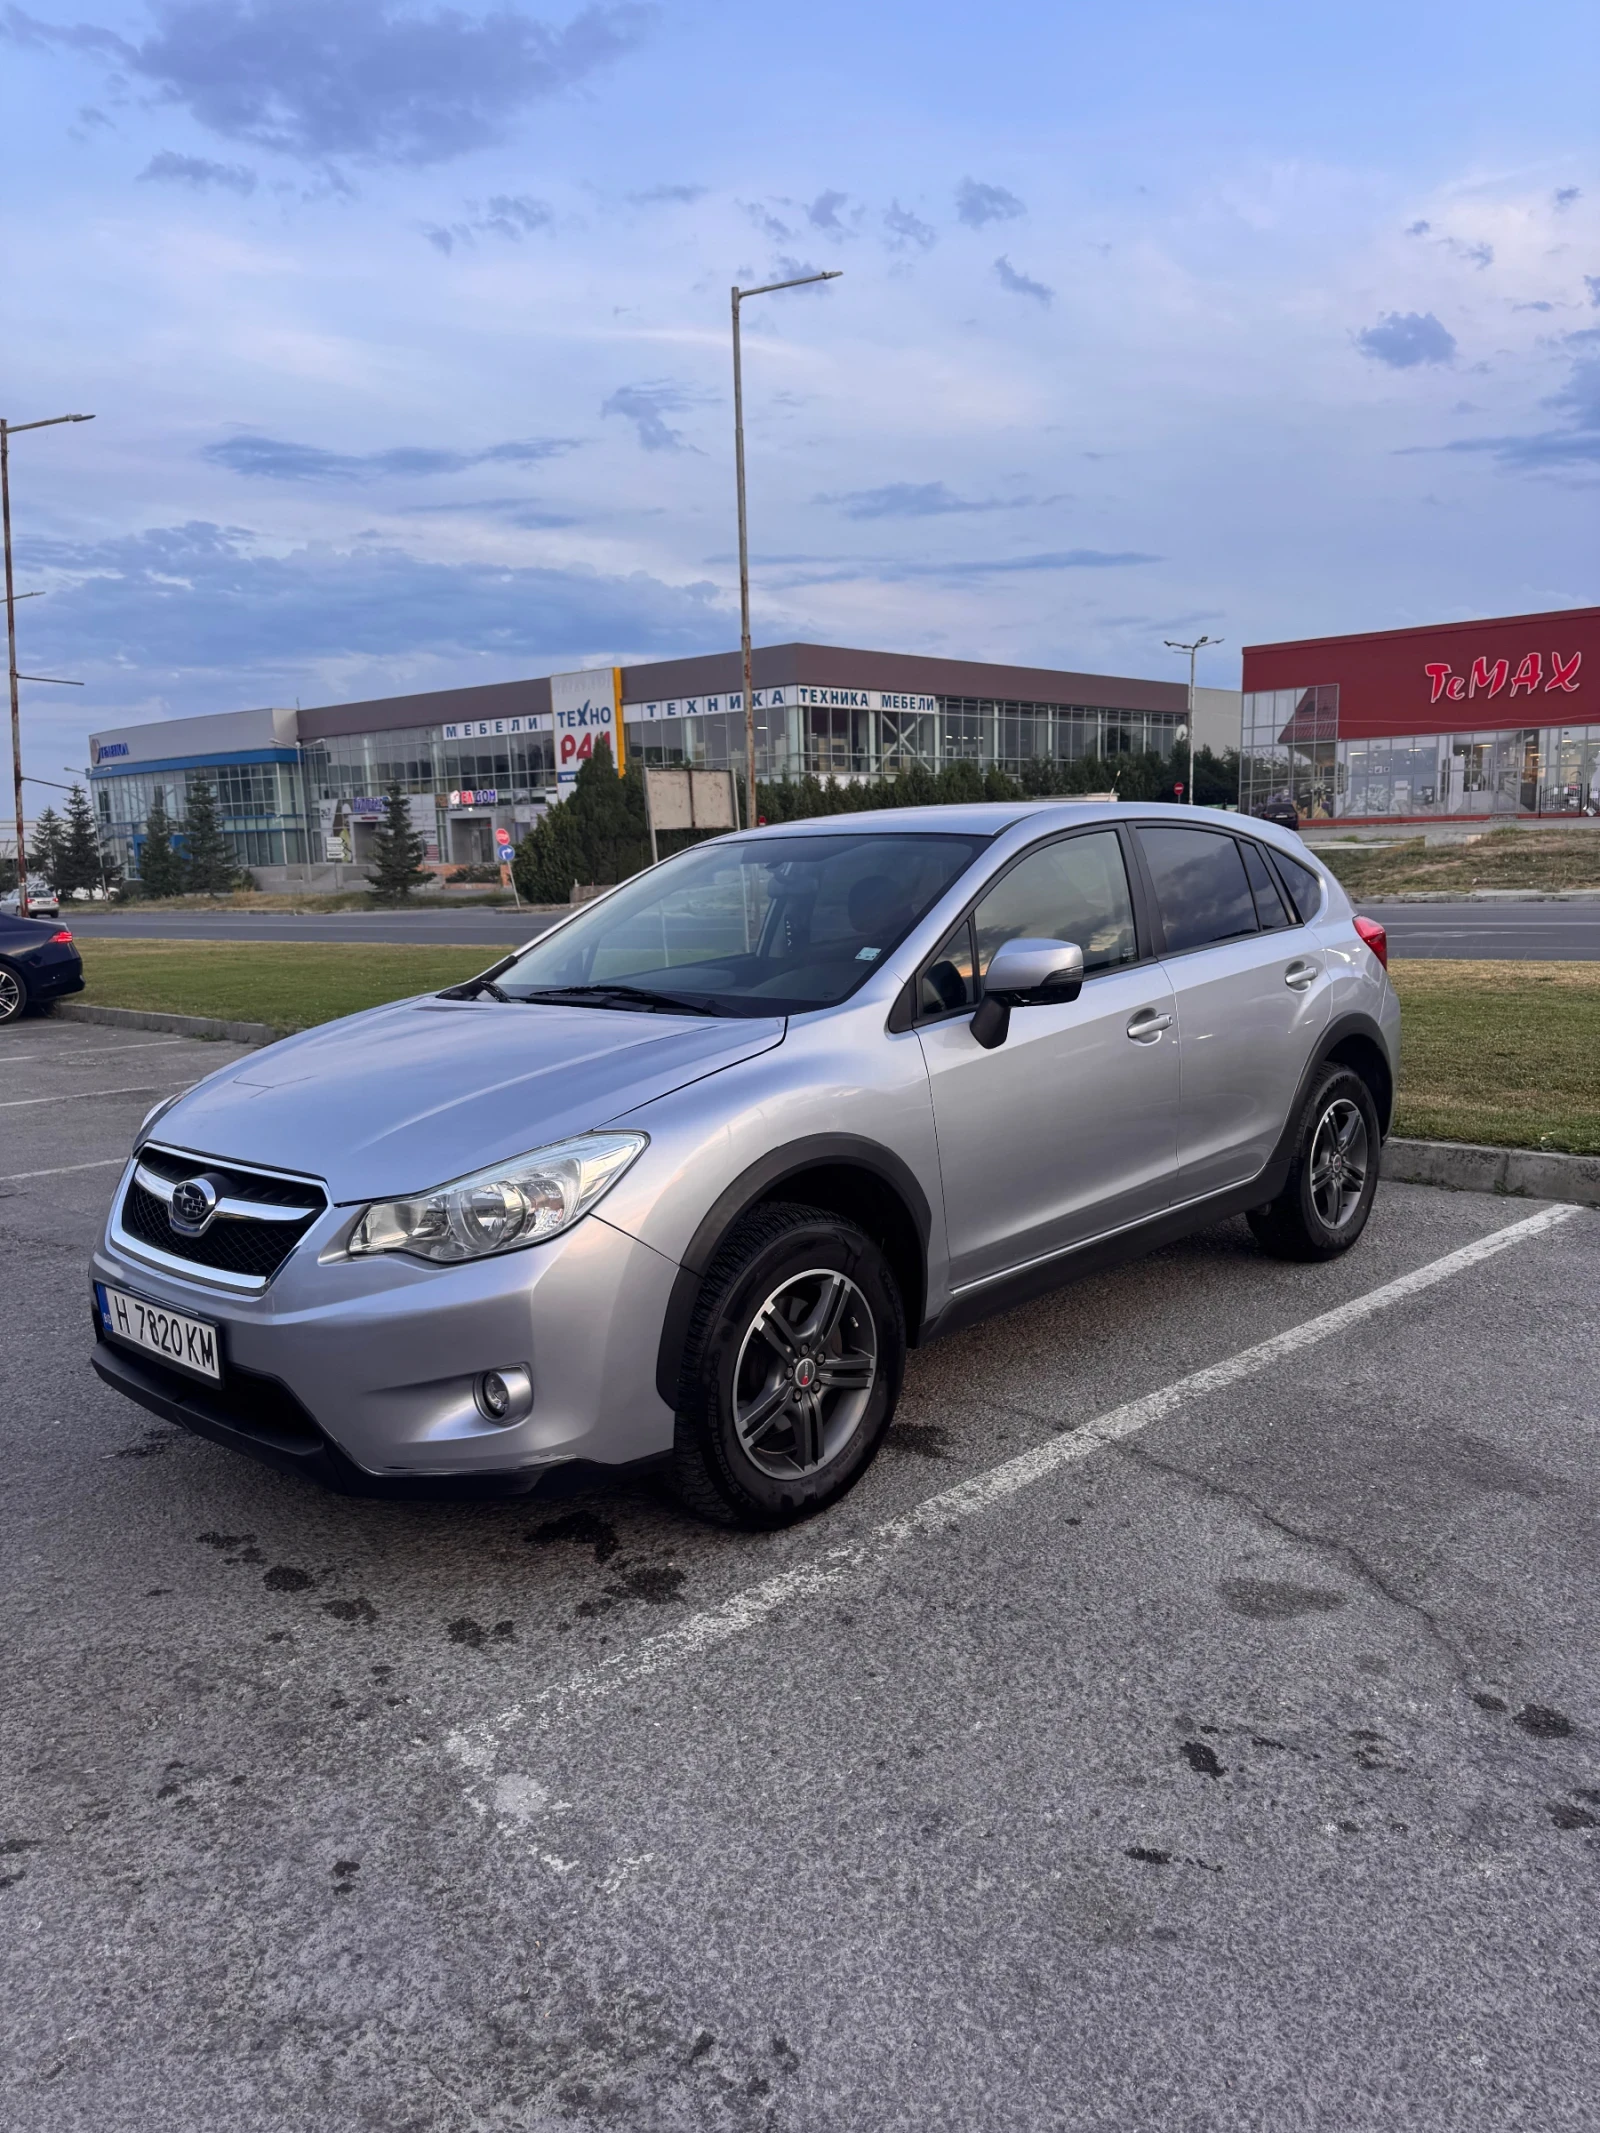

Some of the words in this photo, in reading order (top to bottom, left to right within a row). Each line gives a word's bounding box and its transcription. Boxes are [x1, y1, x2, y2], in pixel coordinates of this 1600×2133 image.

[1425, 652, 1582, 703] TeMAX
[557, 699, 612, 728] ТЕХНО
[646, 689, 785, 718] ТЕХНИКА
[800, 688, 869, 707] ТЕХНИКА
[881, 694, 934, 711] МЕБЕЛИ
[446, 717, 538, 738] МЕБЕЛИ
[114, 1295, 132, 1335] H
[134, 1303, 183, 1357] 7820
[185, 1322, 216, 1372] KM
